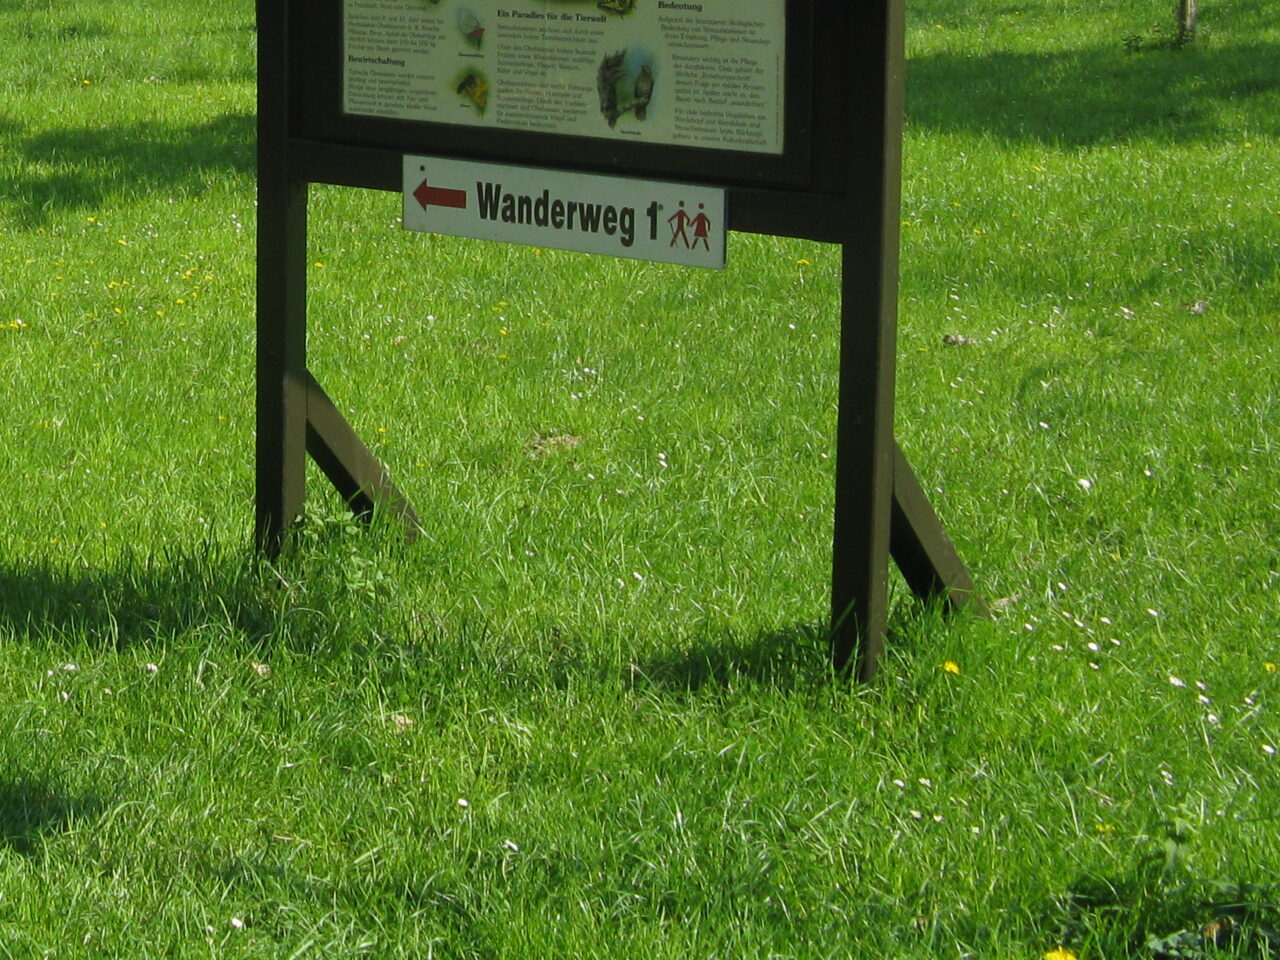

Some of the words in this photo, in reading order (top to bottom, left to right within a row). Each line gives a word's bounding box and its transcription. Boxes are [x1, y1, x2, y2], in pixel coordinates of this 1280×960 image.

[658, 0, 703, 13] Bedeutung
[497, 9, 510, 18] Ein
[512, 10, 545, 19] Paradies
[547, 12, 558, 21] für
[560, 13, 572, 21] die
[576, 13, 607, 23] Tierwelt
[348, 55, 406, 68] Bewirtschaftung
[476, 181, 635, 247] Wanderweg
[646, 201, 658, 240] 1
